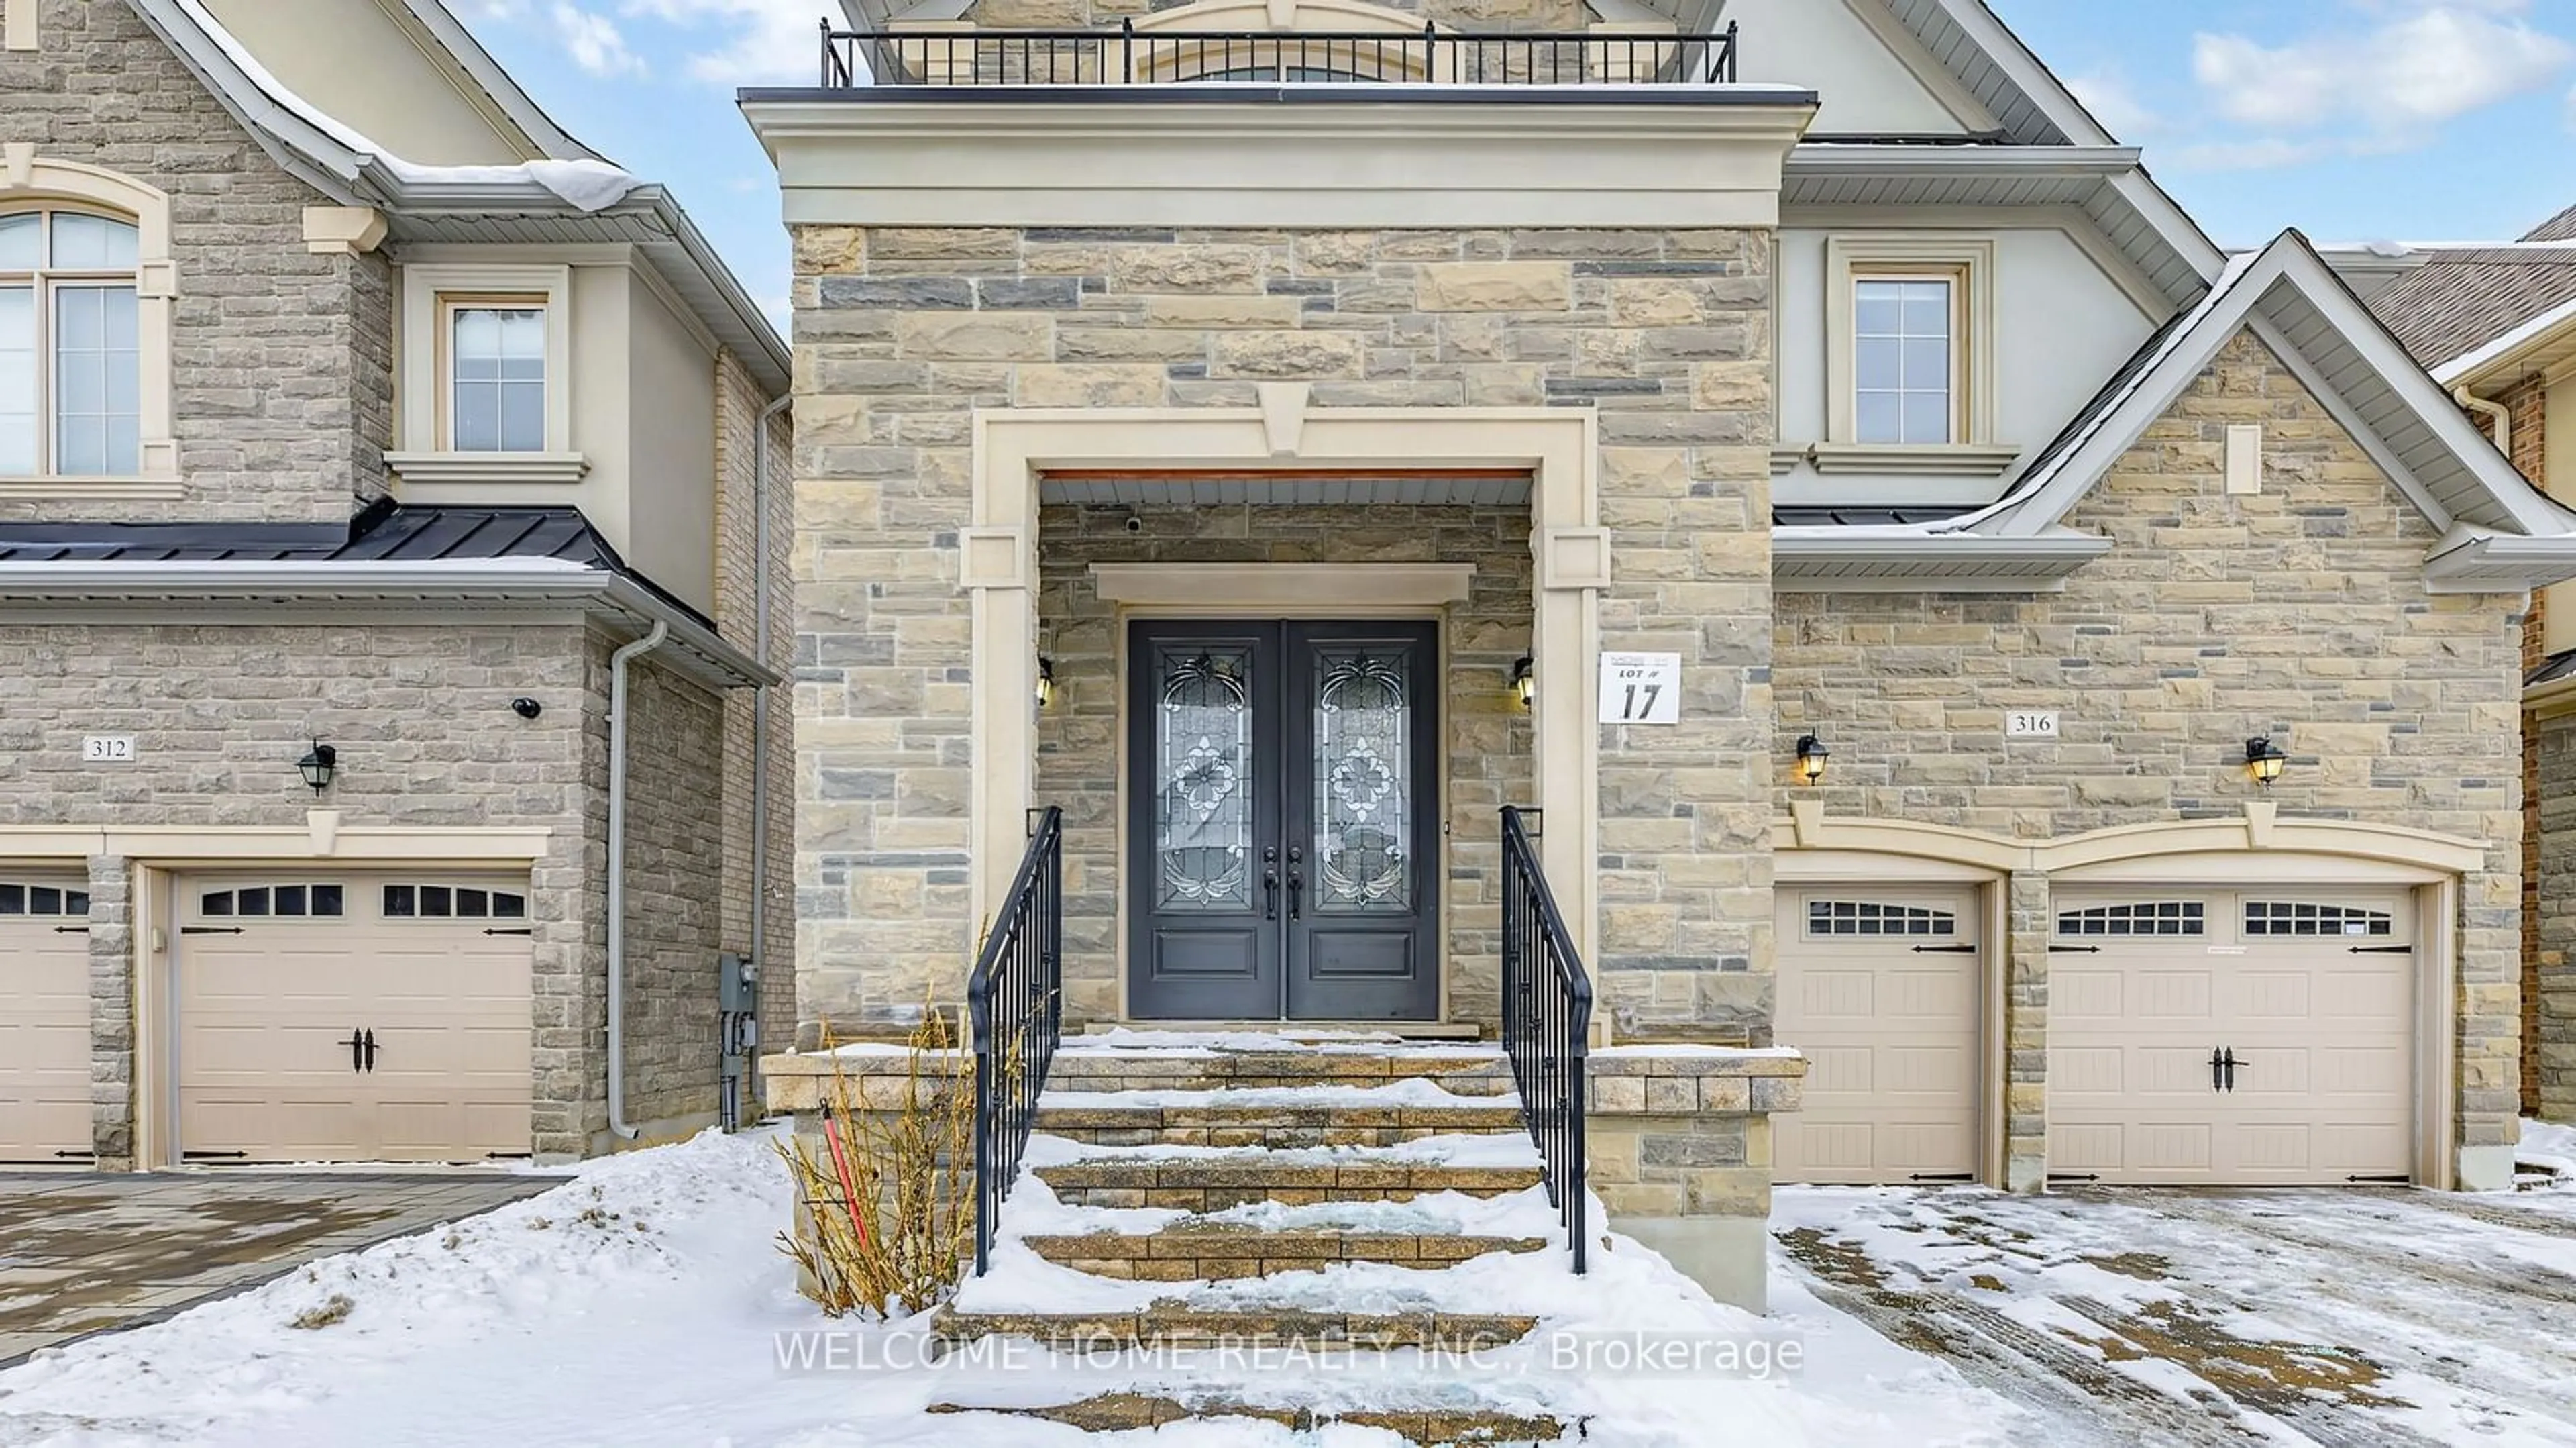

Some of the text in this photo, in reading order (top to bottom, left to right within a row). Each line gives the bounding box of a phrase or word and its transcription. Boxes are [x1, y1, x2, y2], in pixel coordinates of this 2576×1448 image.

[1619, 670, 1644, 678] LOT
[1623, 684, 1662, 720] 17
[2015, 715, 2051, 732] 316
[92, 740, 125, 757] 312
